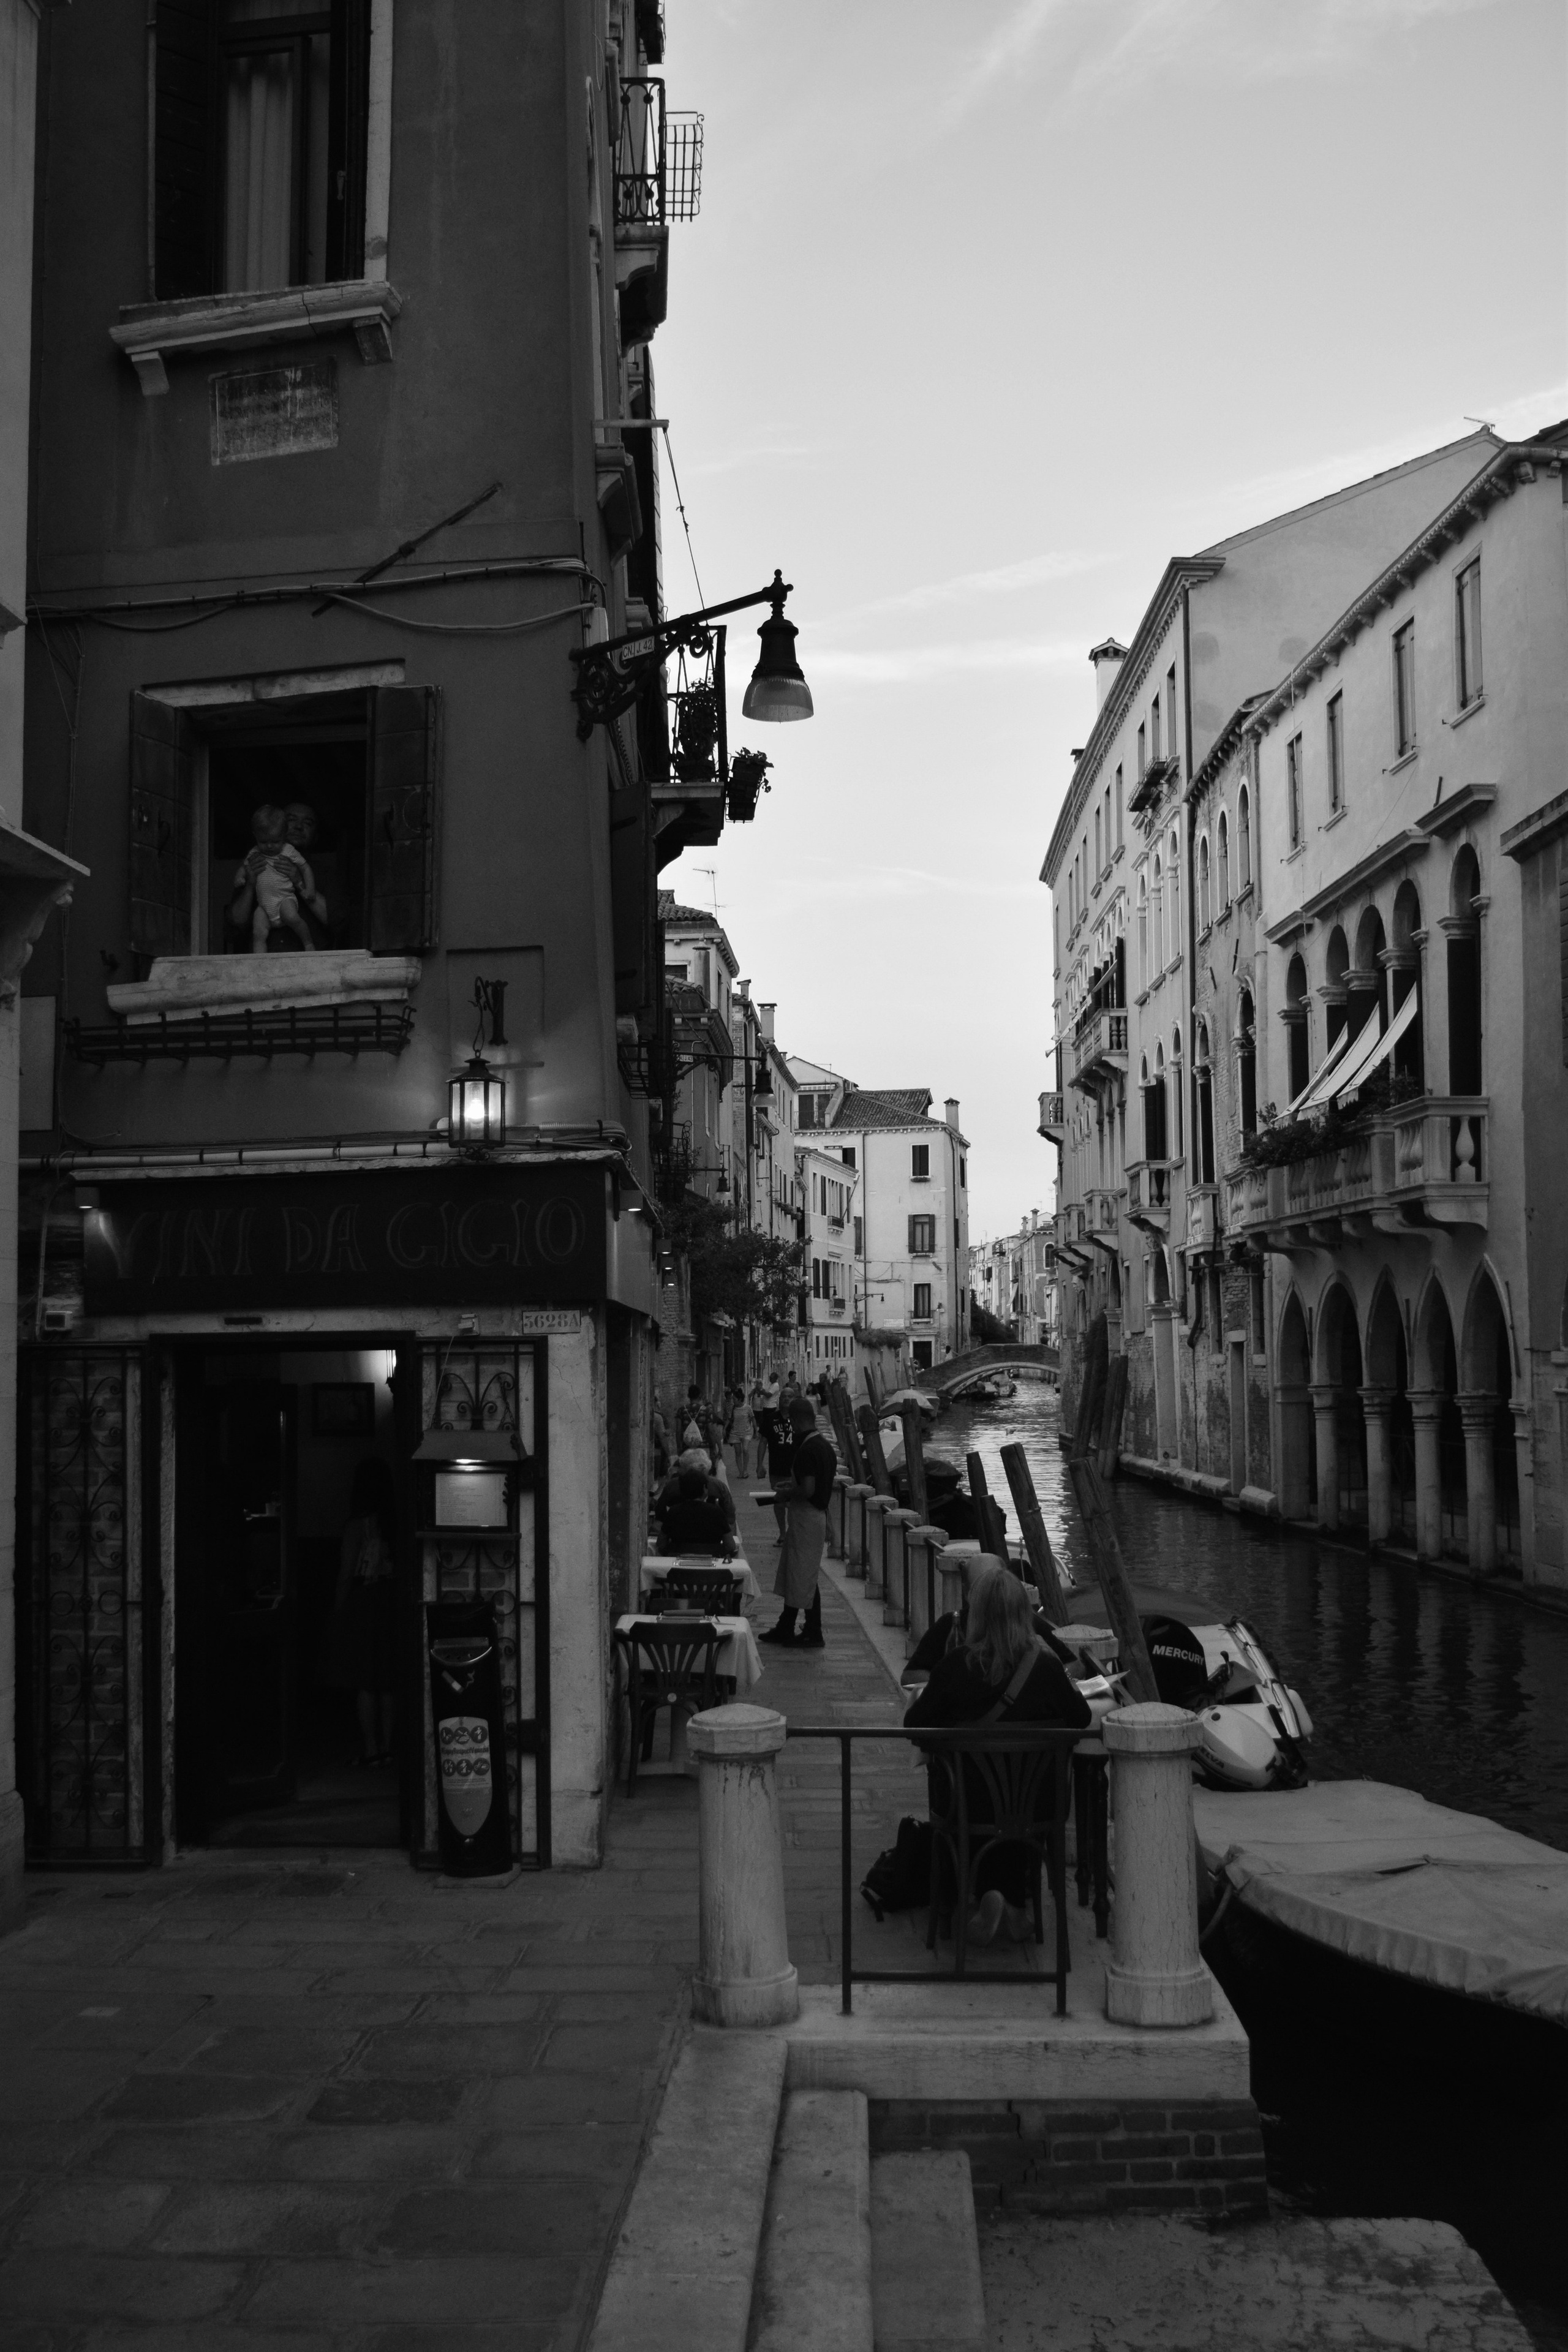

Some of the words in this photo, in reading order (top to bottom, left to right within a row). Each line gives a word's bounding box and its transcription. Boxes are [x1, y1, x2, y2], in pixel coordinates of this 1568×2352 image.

[643, 639, 652, 650] 42
[99, 1208, 257, 1278] VINI
[282, 1204, 367, 1273] DA
[386, 1196, 586, 1268] GIGIO
[524, 1313, 579, 1329] 3628A
[778, 1431, 793, 1445] 34
[1152, 1645, 1204, 1665] MERCURY
